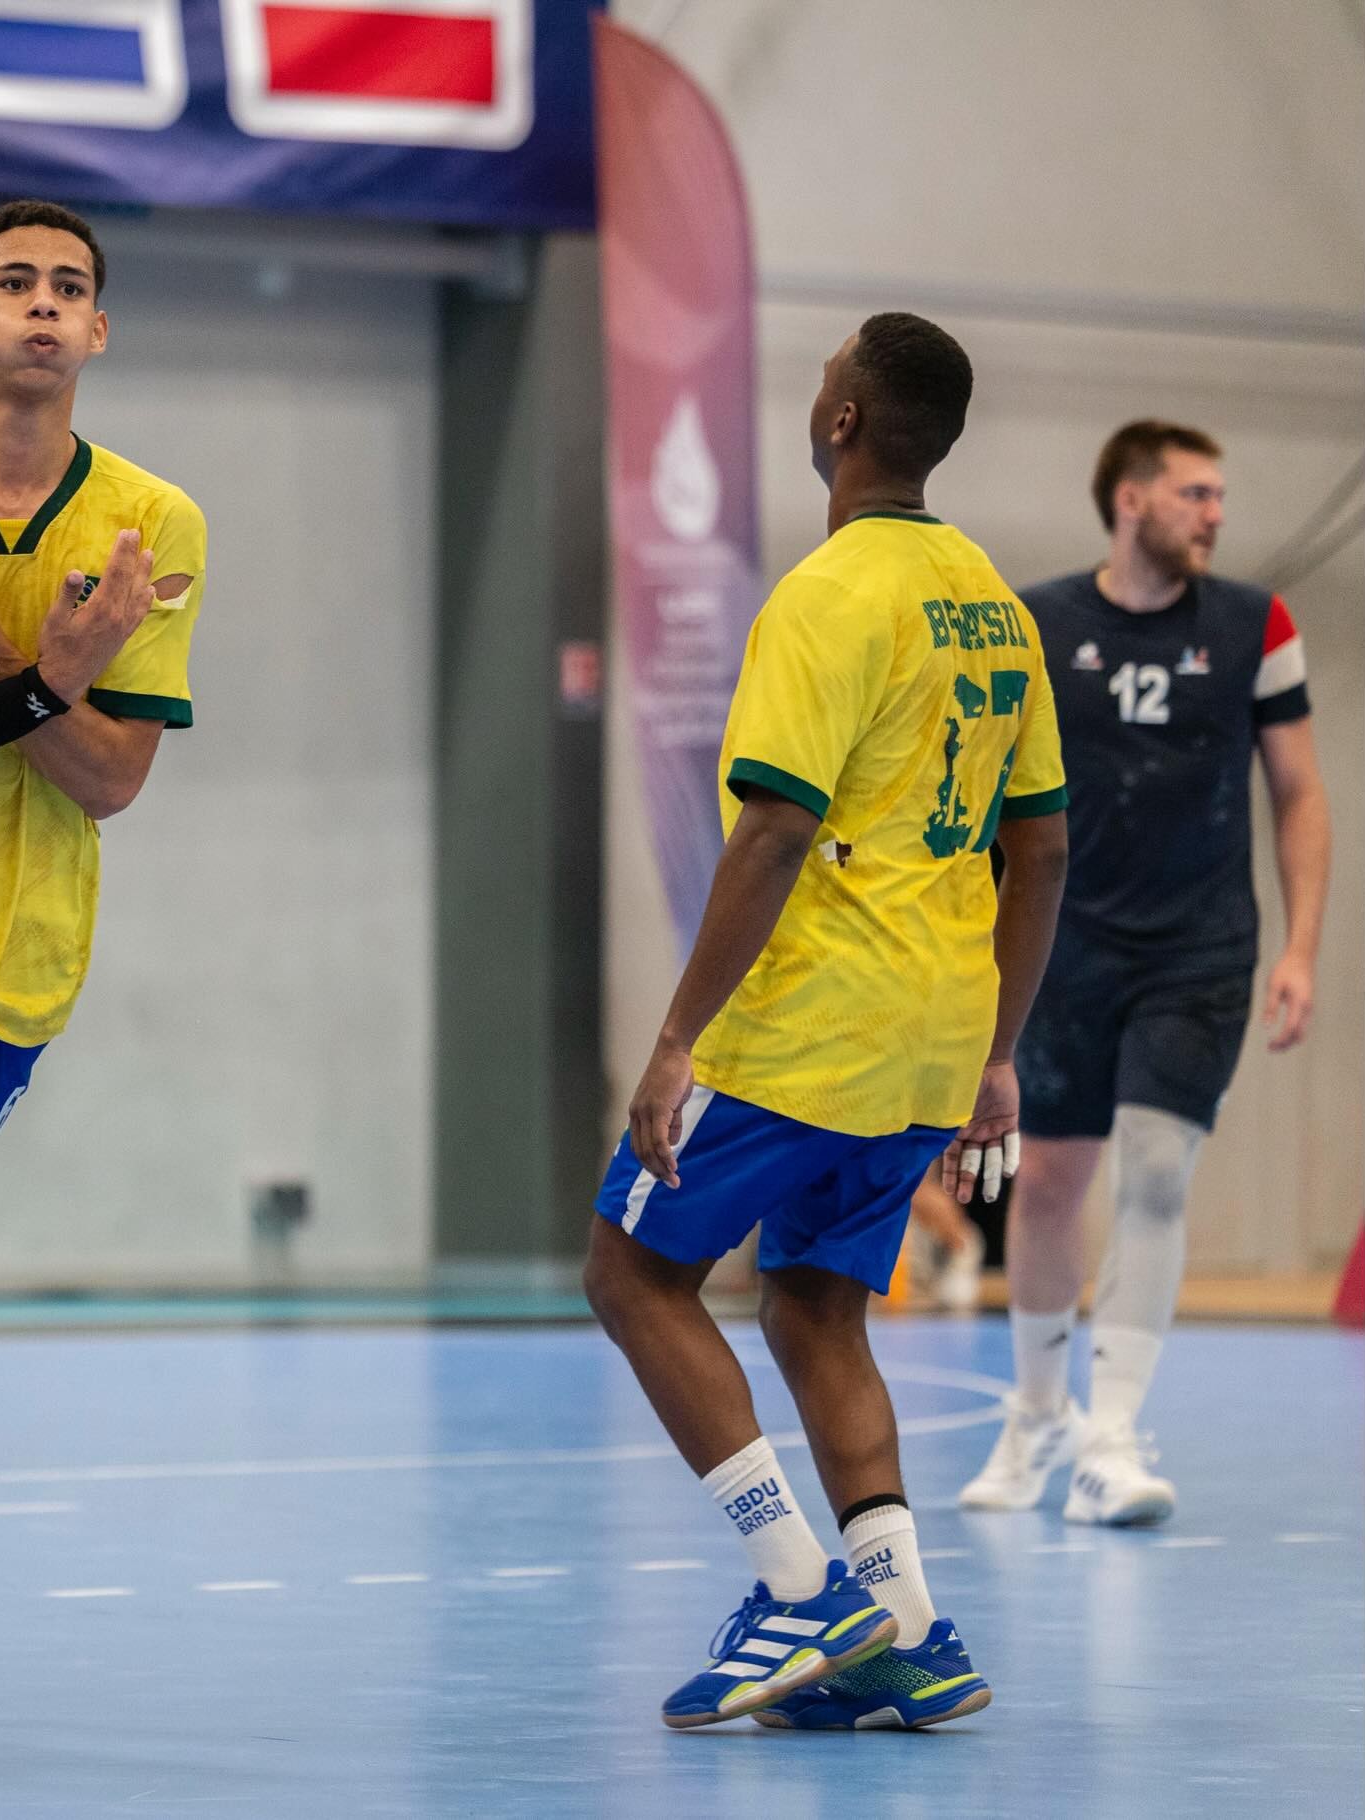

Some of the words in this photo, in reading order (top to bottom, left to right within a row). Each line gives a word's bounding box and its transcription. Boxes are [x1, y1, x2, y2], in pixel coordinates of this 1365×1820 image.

[1108, 661, 1170, 725] 12
[723, 1477, 780, 1520] CBDU
[736, 1498, 792, 1536] BRASIL
[858, 1564, 900, 1587] RASIL
